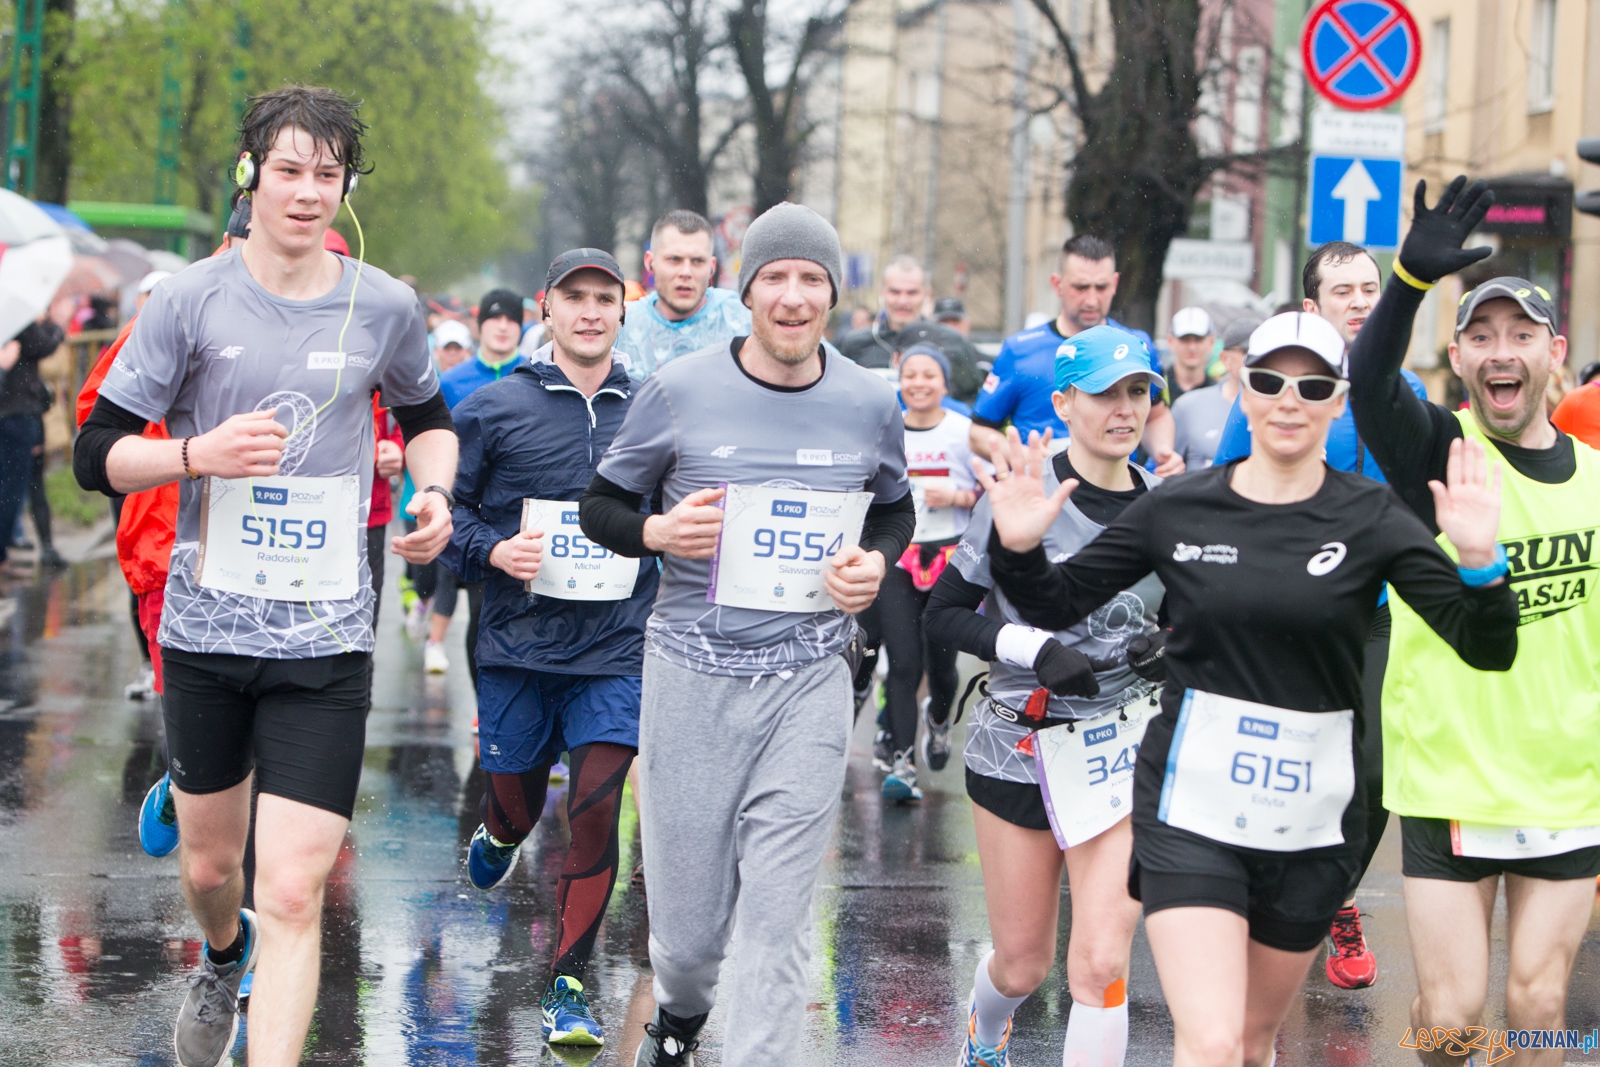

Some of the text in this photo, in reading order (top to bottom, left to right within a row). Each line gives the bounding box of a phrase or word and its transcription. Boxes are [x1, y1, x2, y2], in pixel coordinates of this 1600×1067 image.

[219, 345, 244, 358] 4F
[711, 445, 737, 458] 4F
[241, 514, 327, 550] 5159
[753, 528, 844, 562] 9554
[257, 551, 310, 564] Radosław
[1503, 530, 1595, 573] RUN
[1518, 578, 1585, 610] ASJA
[1230, 751, 1311, 793] 6151
